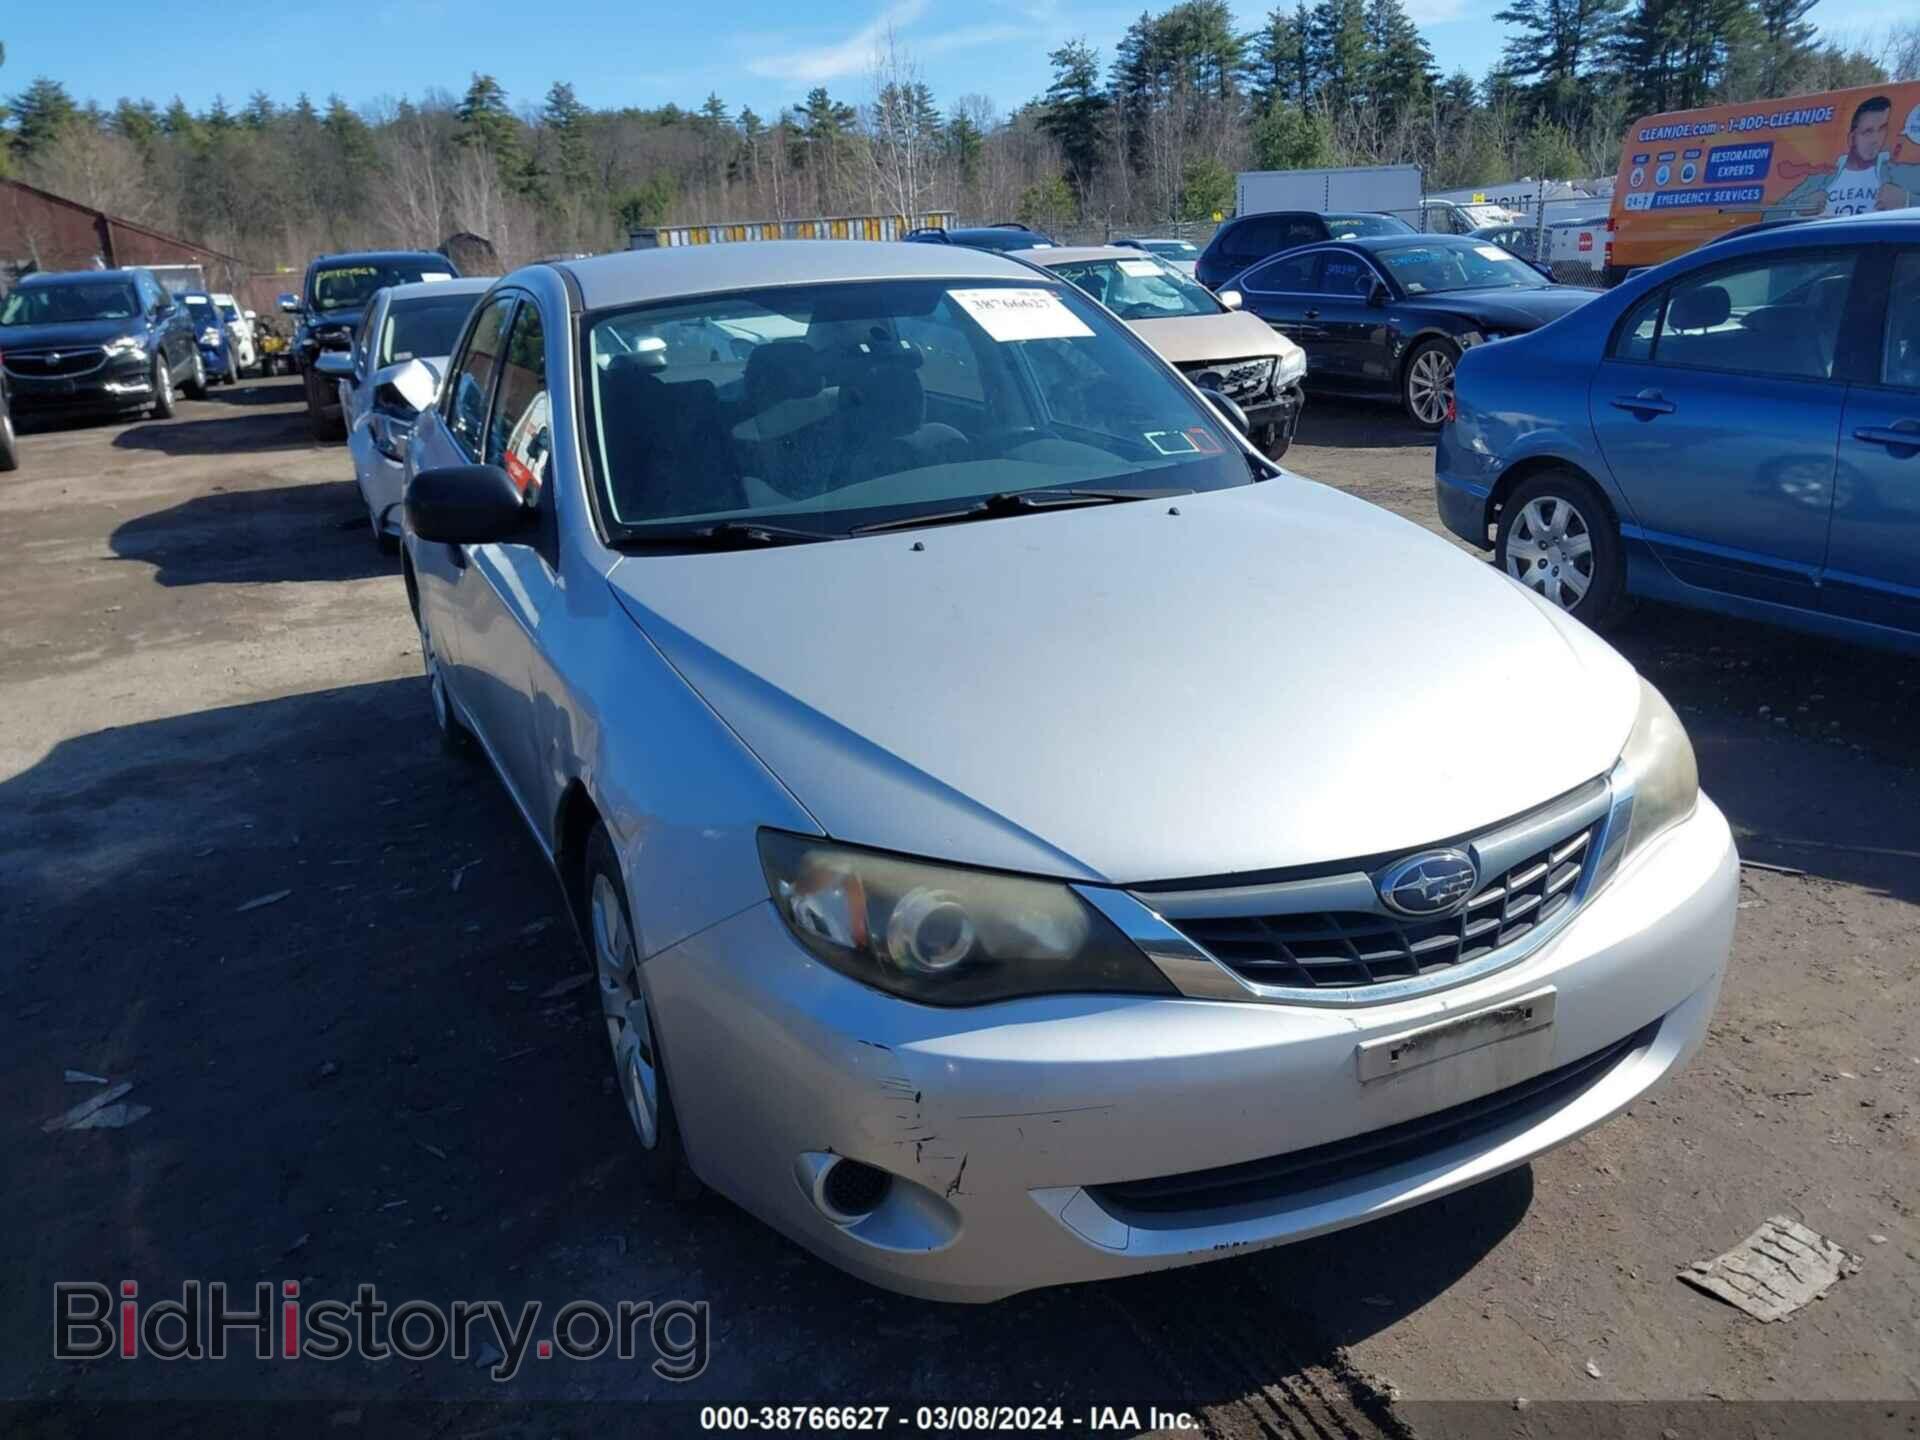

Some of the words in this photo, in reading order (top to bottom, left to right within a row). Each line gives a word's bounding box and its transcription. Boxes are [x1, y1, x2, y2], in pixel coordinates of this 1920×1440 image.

[1638, 121, 1717, 141] CLEANJOE.com
[1728, 106, 1835, 131] 1-800-CLEANJOE
[1711, 148, 1769, 163] RESTORATION
[1717, 164, 1755, 177] EXPERTS
[1656, 191, 1711, 206] EMERGENCY
[1713, 188, 1761, 203] SERVICES
[1827, 187, 1878, 203] CLEAN
